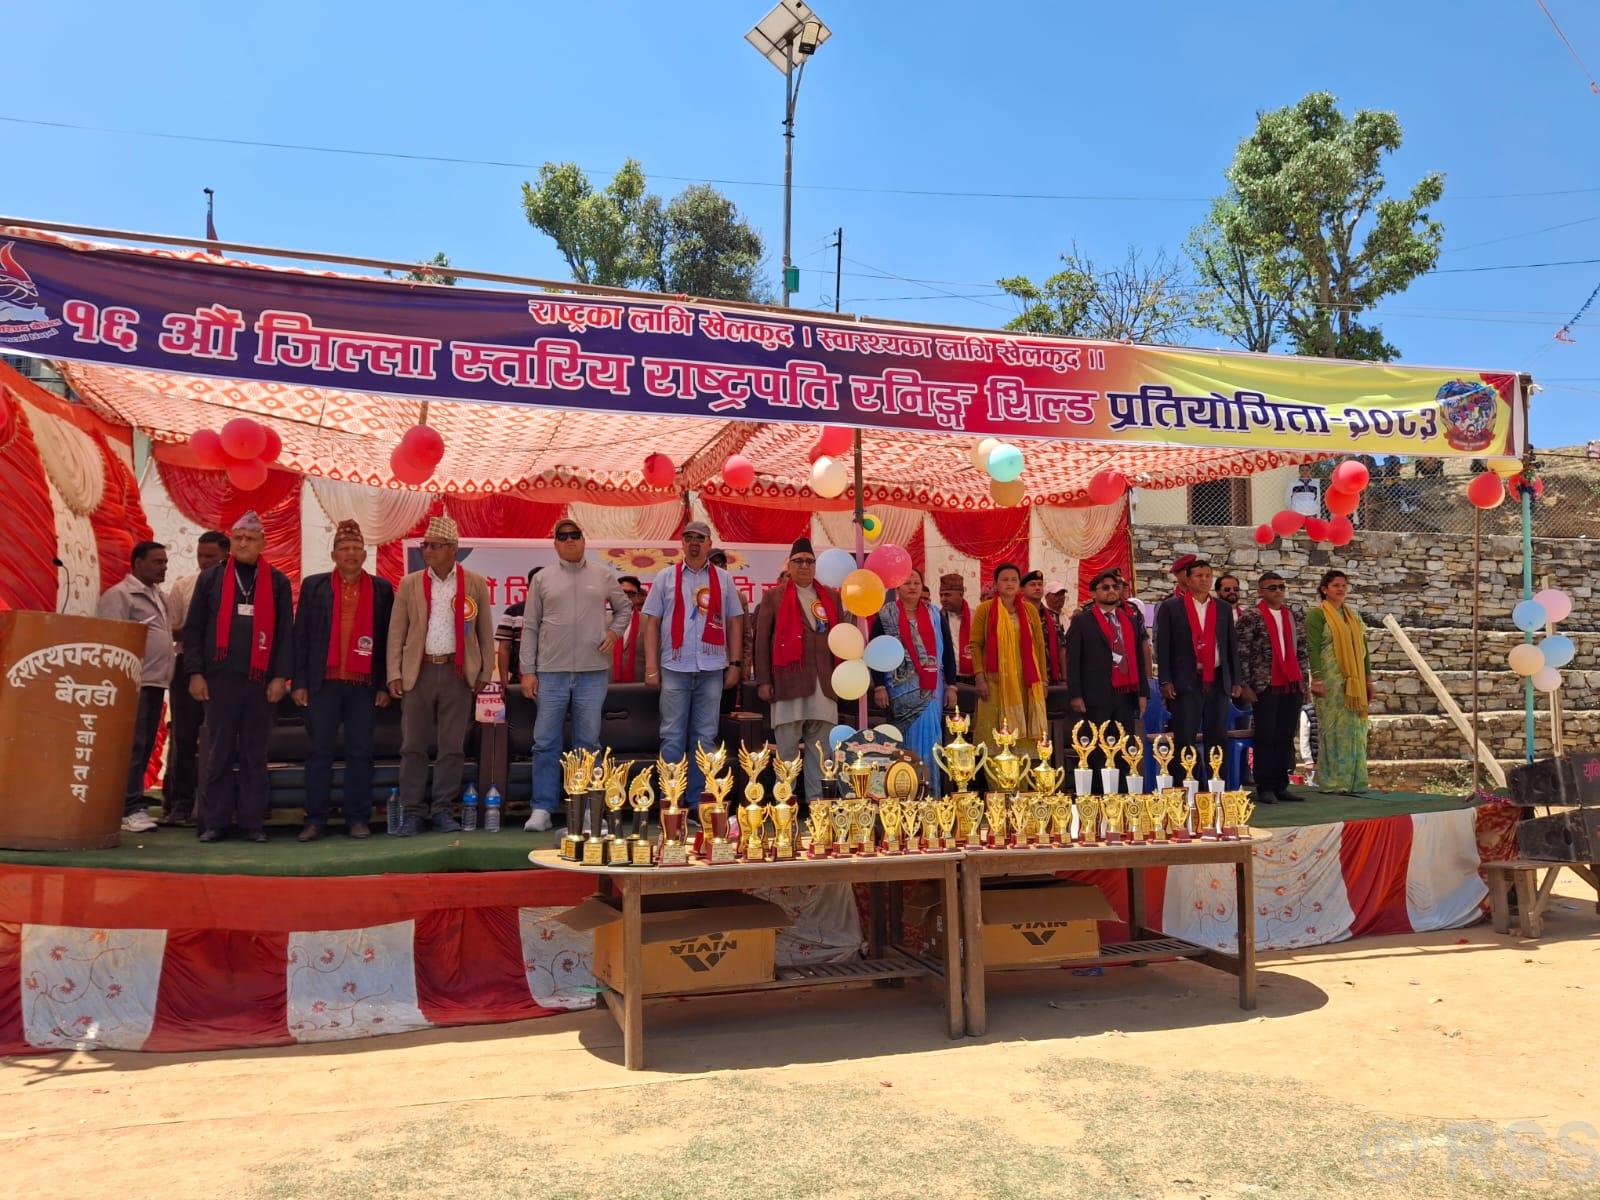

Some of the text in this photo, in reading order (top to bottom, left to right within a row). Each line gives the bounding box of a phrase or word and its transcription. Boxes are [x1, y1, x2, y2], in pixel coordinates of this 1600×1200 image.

[63, 299, 140, 352] १६
[254, 309, 441, 380] जिल्ला
[450, 337, 634, 396] स्तरिय
[642, 360, 841, 411] राष्ट्रपति
[984, 376, 1098, 424] शिल्ड
[528, 300, 624, 333] राष्ट्रका
[628, 305, 693, 336] लागि
[700, 312, 793, 350] खेलकुद
[817, 328, 931, 357] स्वास्थ्यका
[936, 336, 993, 362] लागि
[996, 340, 1080, 373] खेलकुद
[54, 675, 118, 706] बैतडी
[669, 939, 738, 955] NIVIA
